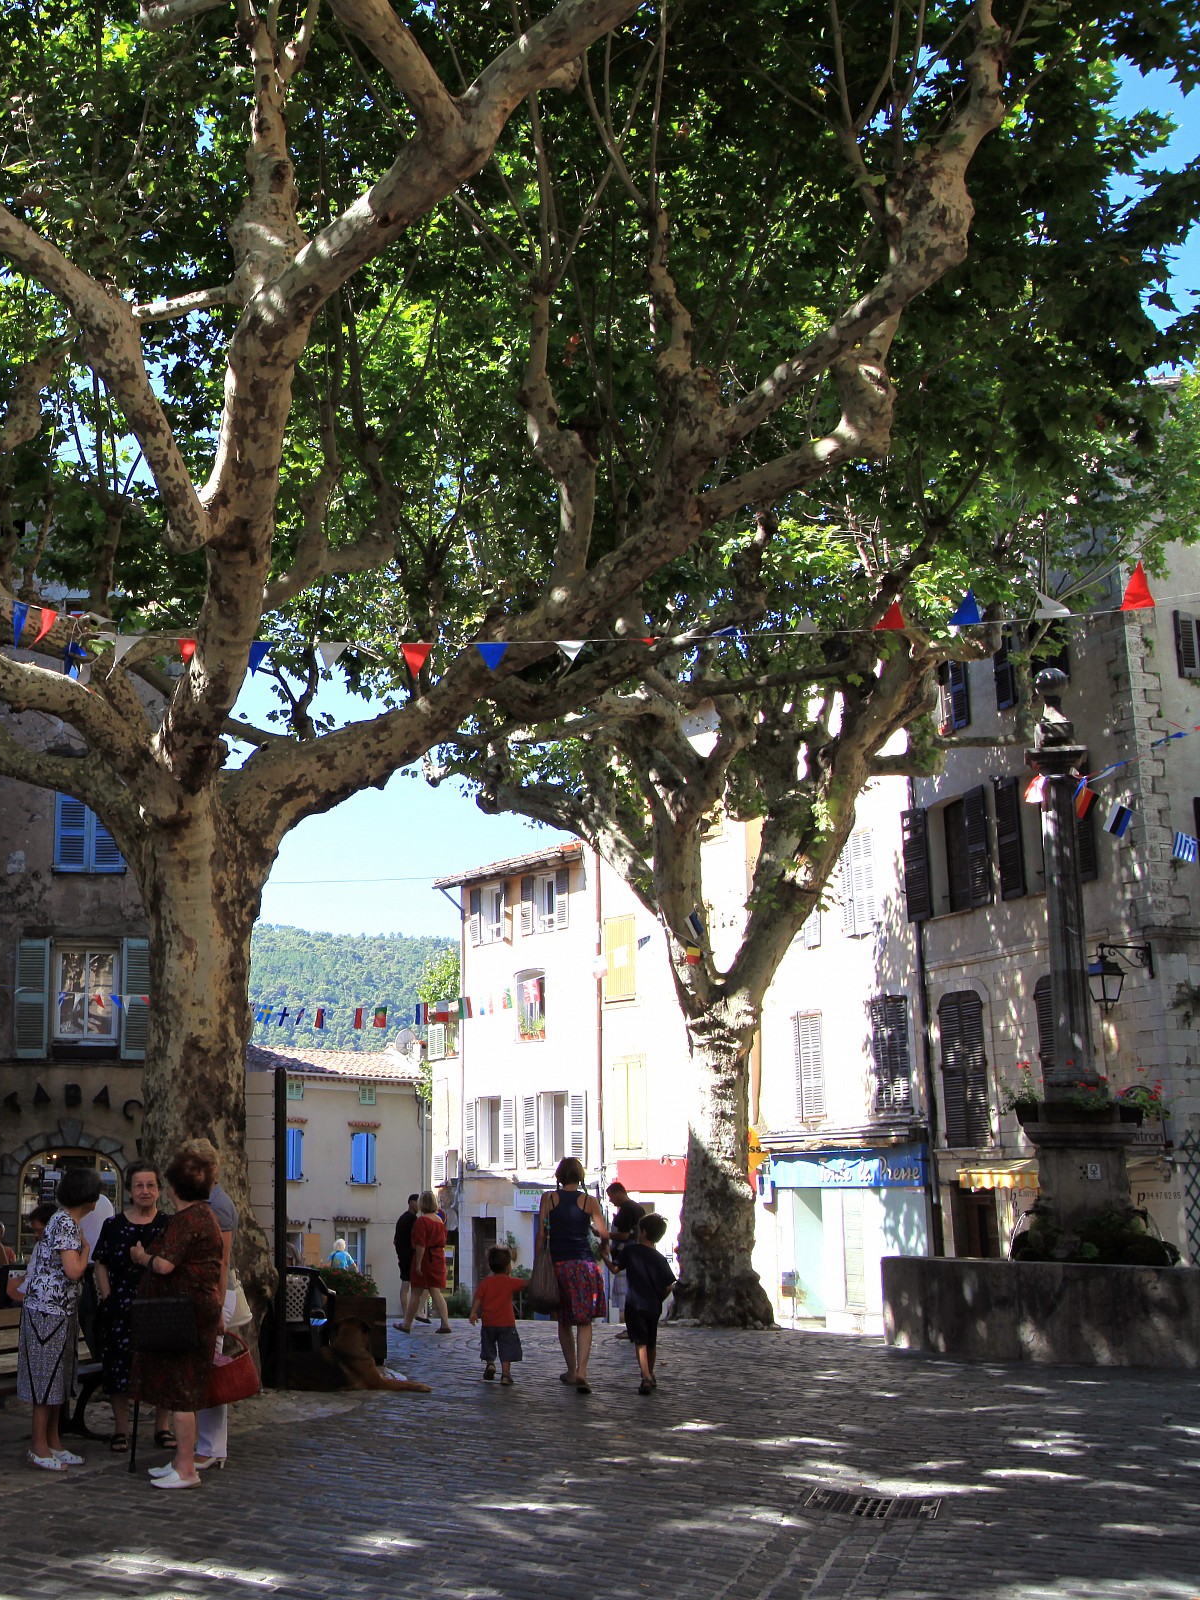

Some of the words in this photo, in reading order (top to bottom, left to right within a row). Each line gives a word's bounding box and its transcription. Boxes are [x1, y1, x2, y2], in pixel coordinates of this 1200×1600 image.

[1134, 1130, 1164, 1142] itron
[858, 1156, 874, 1182] la
[878, 1156, 921, 1181] Presse
